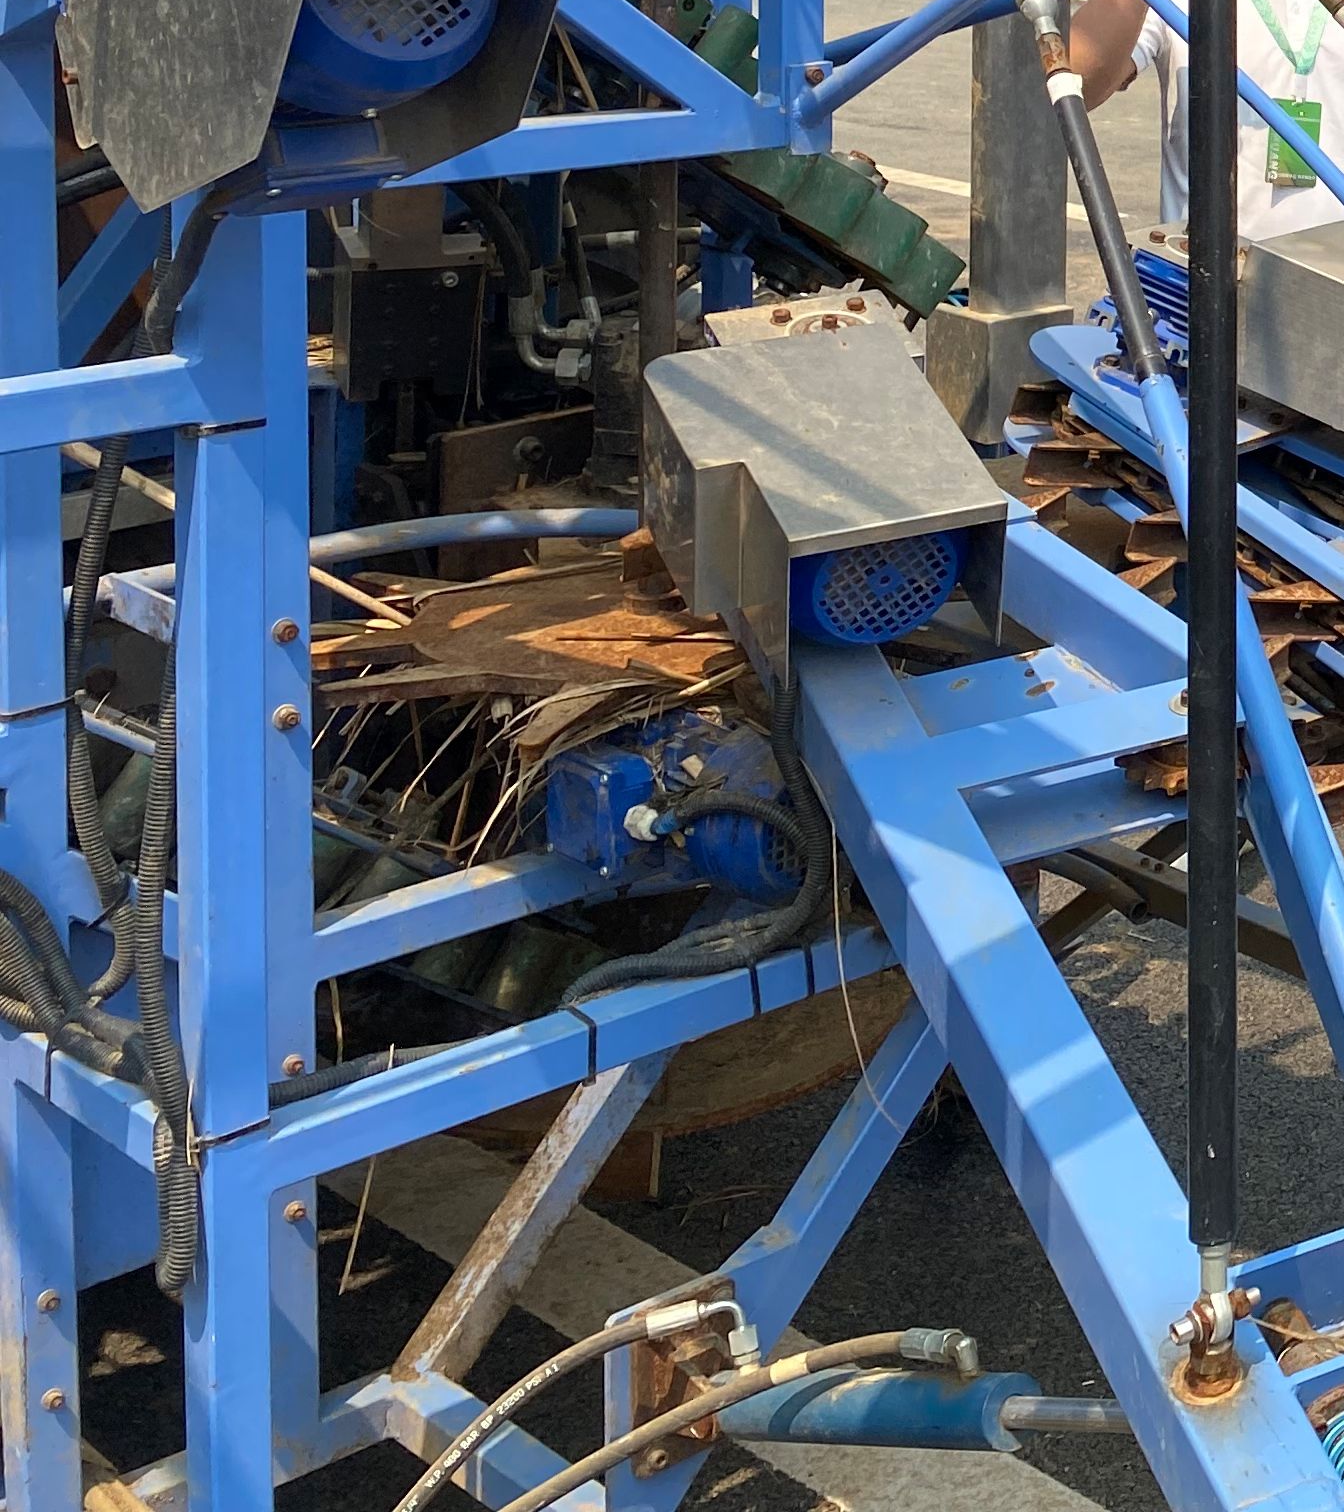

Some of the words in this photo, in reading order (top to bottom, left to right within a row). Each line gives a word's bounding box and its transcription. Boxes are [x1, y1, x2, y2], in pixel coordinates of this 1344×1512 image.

[424, 1469, 446, 1488] W.P.
[460, 1430, 480, 1450] BAR
[496, 1388, 526, 1416] 23200
